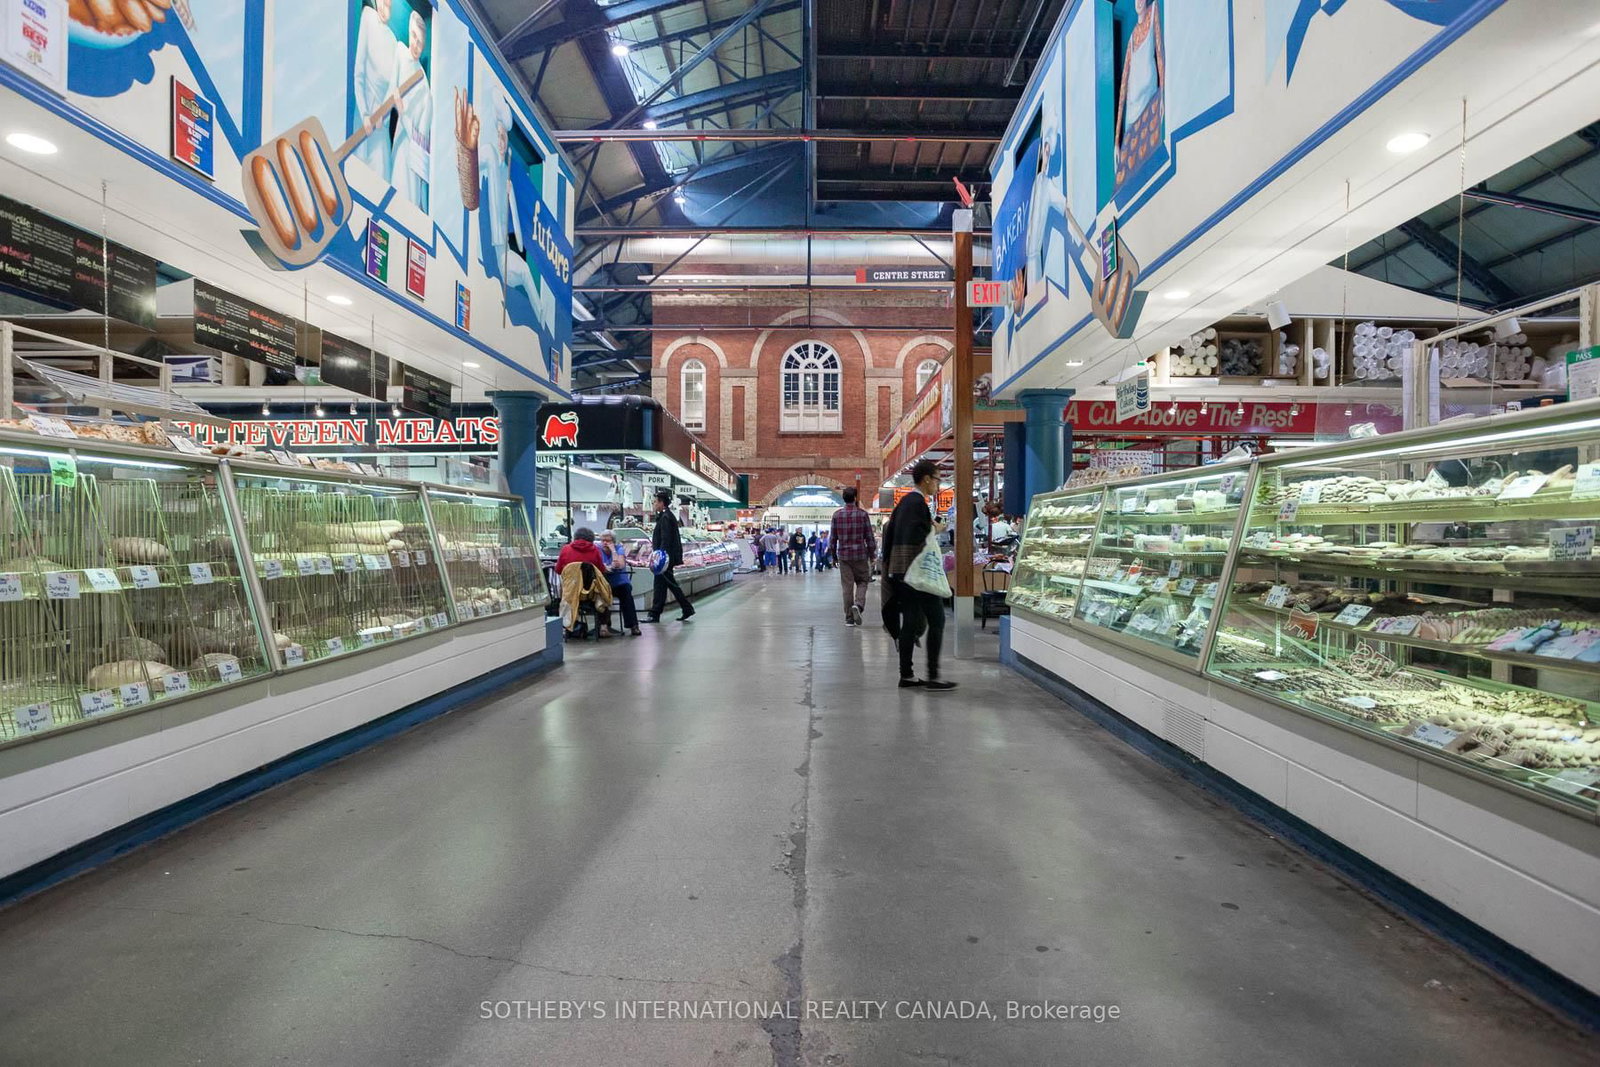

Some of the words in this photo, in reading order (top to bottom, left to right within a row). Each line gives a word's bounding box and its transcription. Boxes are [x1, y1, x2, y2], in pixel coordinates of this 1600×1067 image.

[532, 200, 569, 284] future
[996, 200, 1029, 273] BAKERY
[873, 271, 908, 280] CENTRE
[911, 271, 946, 280] STREET
[973, 283, 1000, 304] EXIT
[1575, 352, 1592, 361] PASS
[1116, 384, 1136, 399] Birthday
[1065, 401, 1079, 424] A
[1089, 401, 1121, 425] Cu
[1133, 402, 1197, 426] Above
[1208, 403, 1243, 427] The
[1250, 404, 1294, 427] Rest
[155, 419, 368, 447] ITTEVEEN
[376, 418, 500, 446] MEATS
[536, 455, 559, 463] ULTRY
